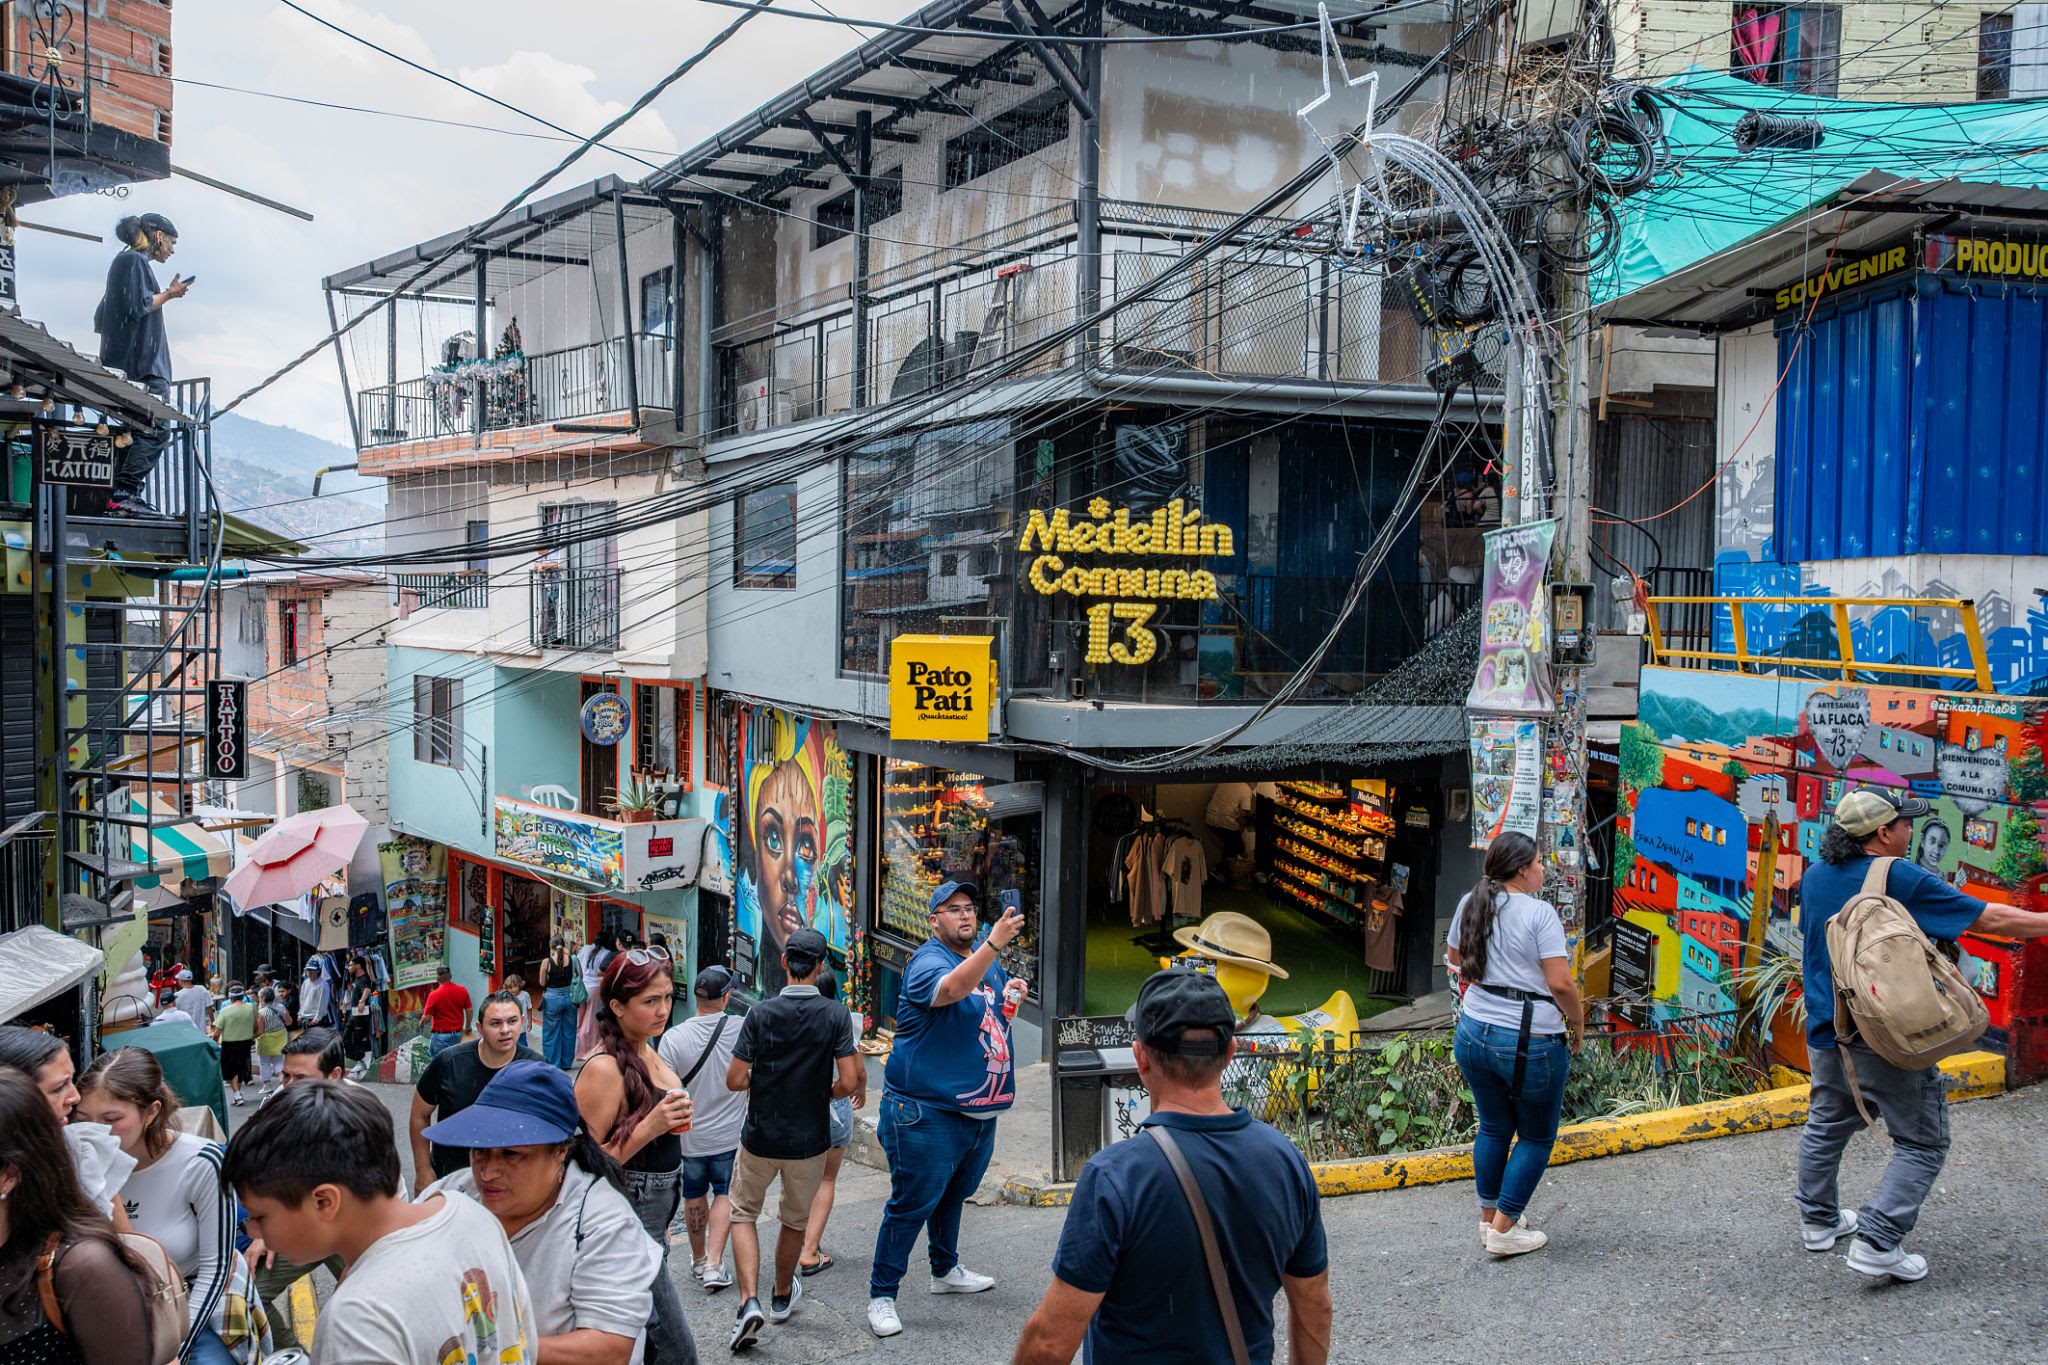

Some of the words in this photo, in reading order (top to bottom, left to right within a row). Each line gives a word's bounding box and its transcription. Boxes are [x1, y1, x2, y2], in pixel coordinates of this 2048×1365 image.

[1775, 246, 1906, 311] SOUVENIR
[46, 459, 112, 480] TATTOO
[1019, 497, 1236, 557] Medellín
[1501, 529, 1538, 549] FLACA
[1028, 555, 1219, 600] Comuna
[1504, 556, 1521, 584] 13
[1084, 602, 1158, 665] 13
[906, 661, 972, 687] Pato
[914, 686, 974, 712] Patí
[1929, 699, 2018, 717] @erikazapata08
[217, 683, 237, 774] TATTOO
[1812, 712, 1827, 726] LA
[1828, 712, 1868, 727] FLACA
[1829, 734, 1846, 757] 13
[1942, 753, 2001, 767] BIENVENIDOS
[1960, 770, 1967, 778] A
[1969, 771, 1980, 779] LA
[1946, 782, 1985, 795] COMUNA
[1986, 788, 1998, 797] 13
[523, 822, 592, 849] CREMAS
[537, 842, 576, 862] Alba
